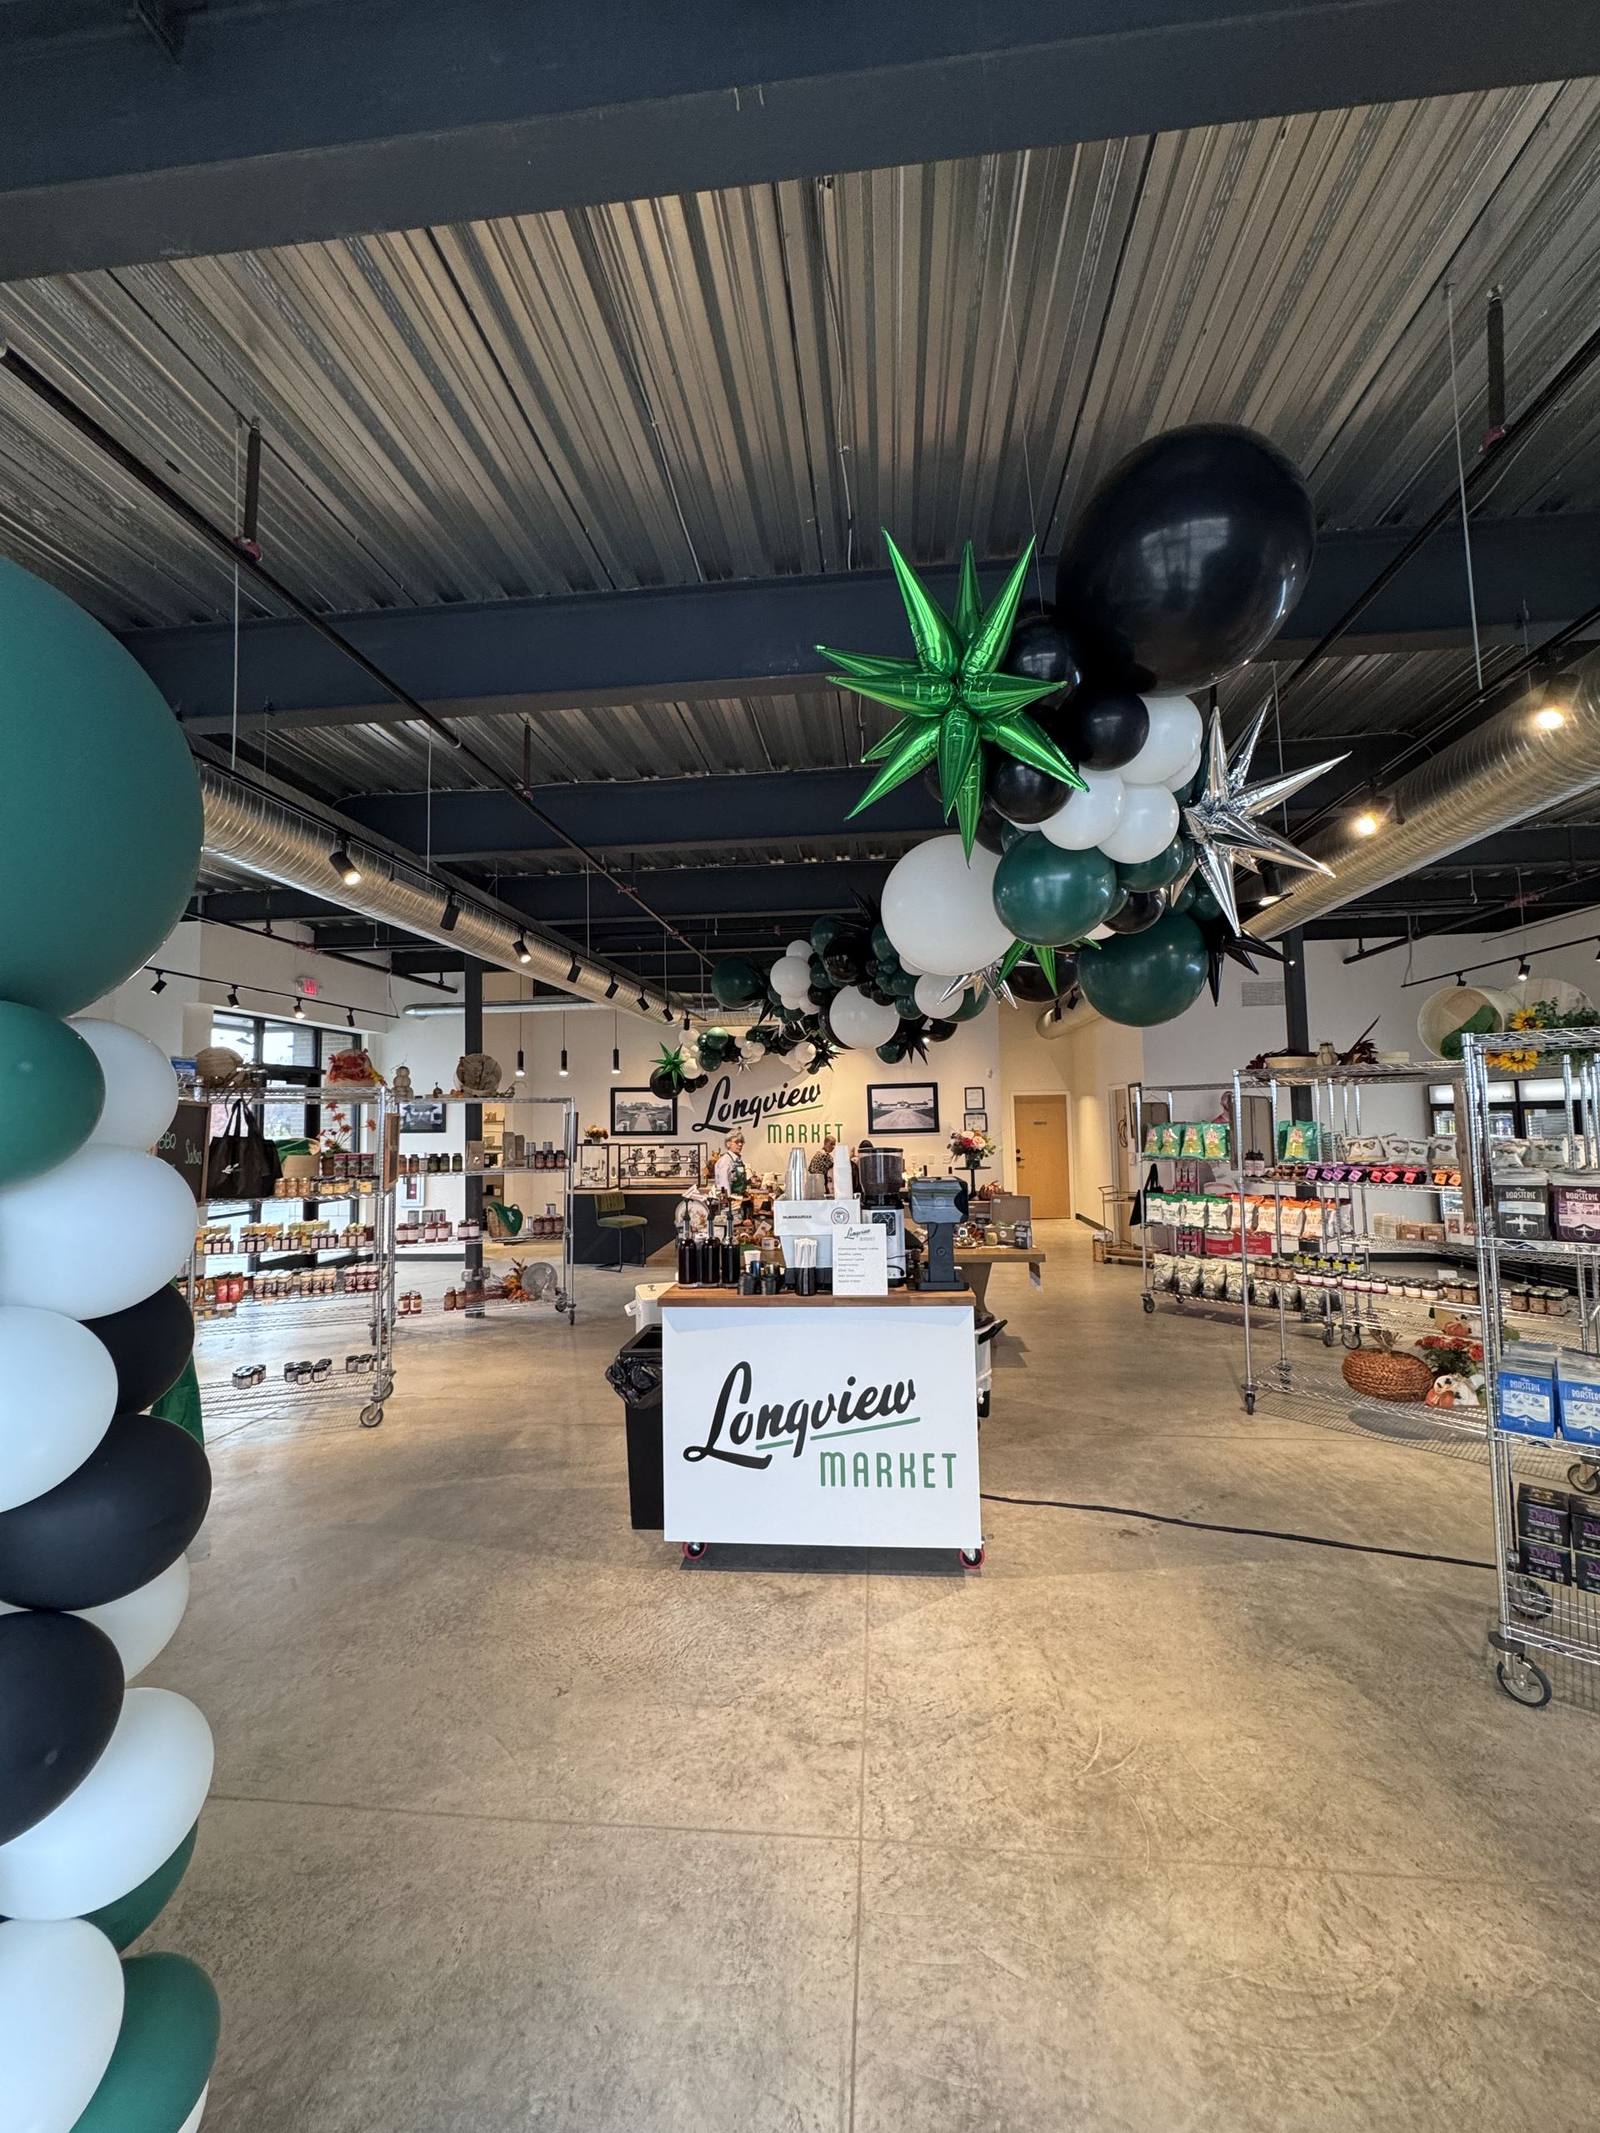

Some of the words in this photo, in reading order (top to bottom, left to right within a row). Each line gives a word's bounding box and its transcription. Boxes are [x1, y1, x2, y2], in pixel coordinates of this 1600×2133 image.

[691, 1076, 821, 1134] Longview
[767, 1123, 844, 1144] MARKET
[1505, 1191, 1537, 1200] ROASTERIE
[1565, 1191, 1599, 1201] ROASTERIE
[683, 1361, 917, 1470] Longview
[819, 1451, 958, 1489] MARKET
